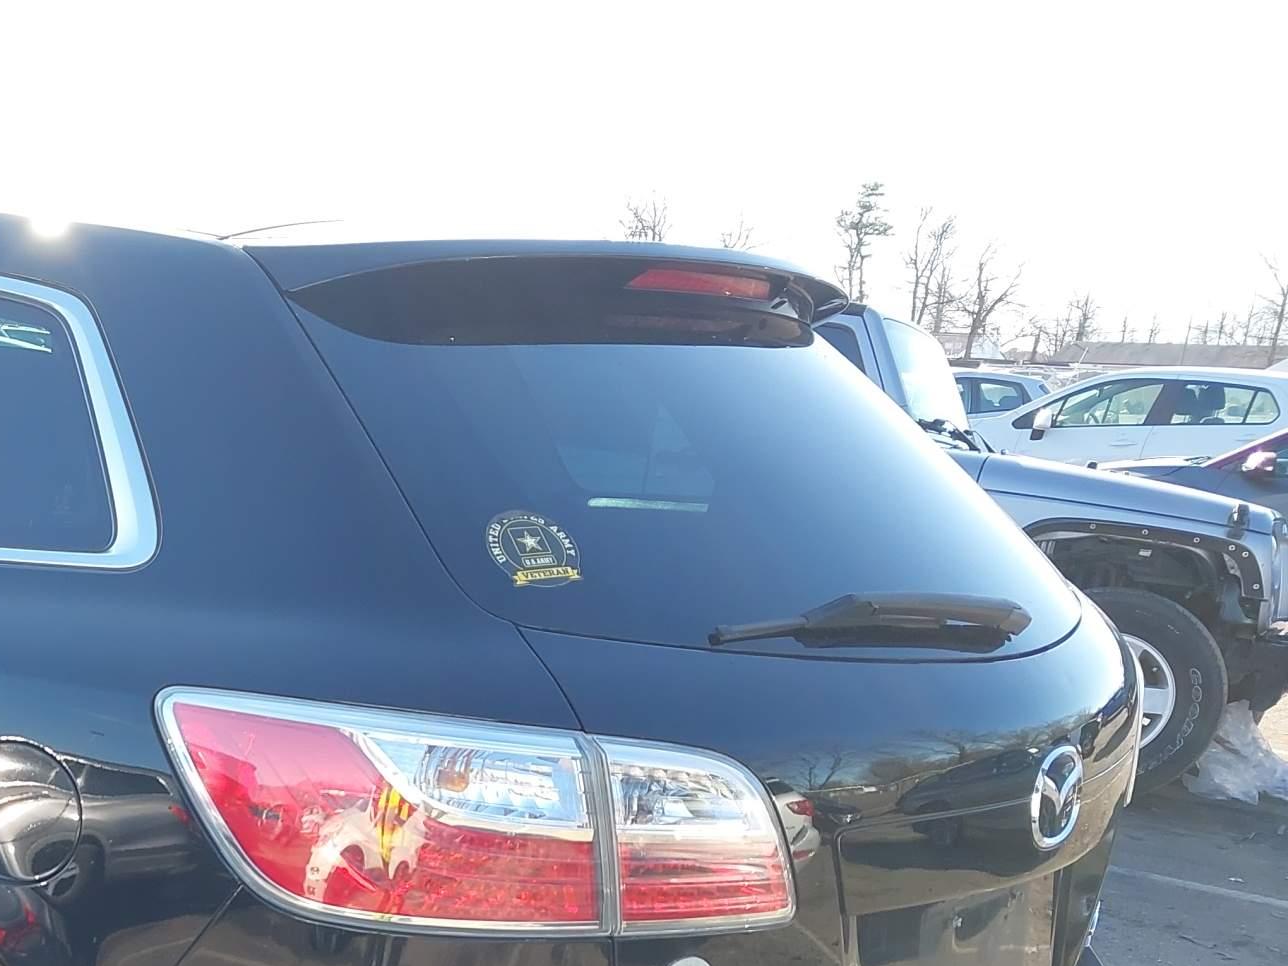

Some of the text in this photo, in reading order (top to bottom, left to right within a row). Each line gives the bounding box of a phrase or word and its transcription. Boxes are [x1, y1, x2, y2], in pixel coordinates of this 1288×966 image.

[488, 522, 576, 564] UNITED ARMY
[521, 568, 570, 580] VETERAN
